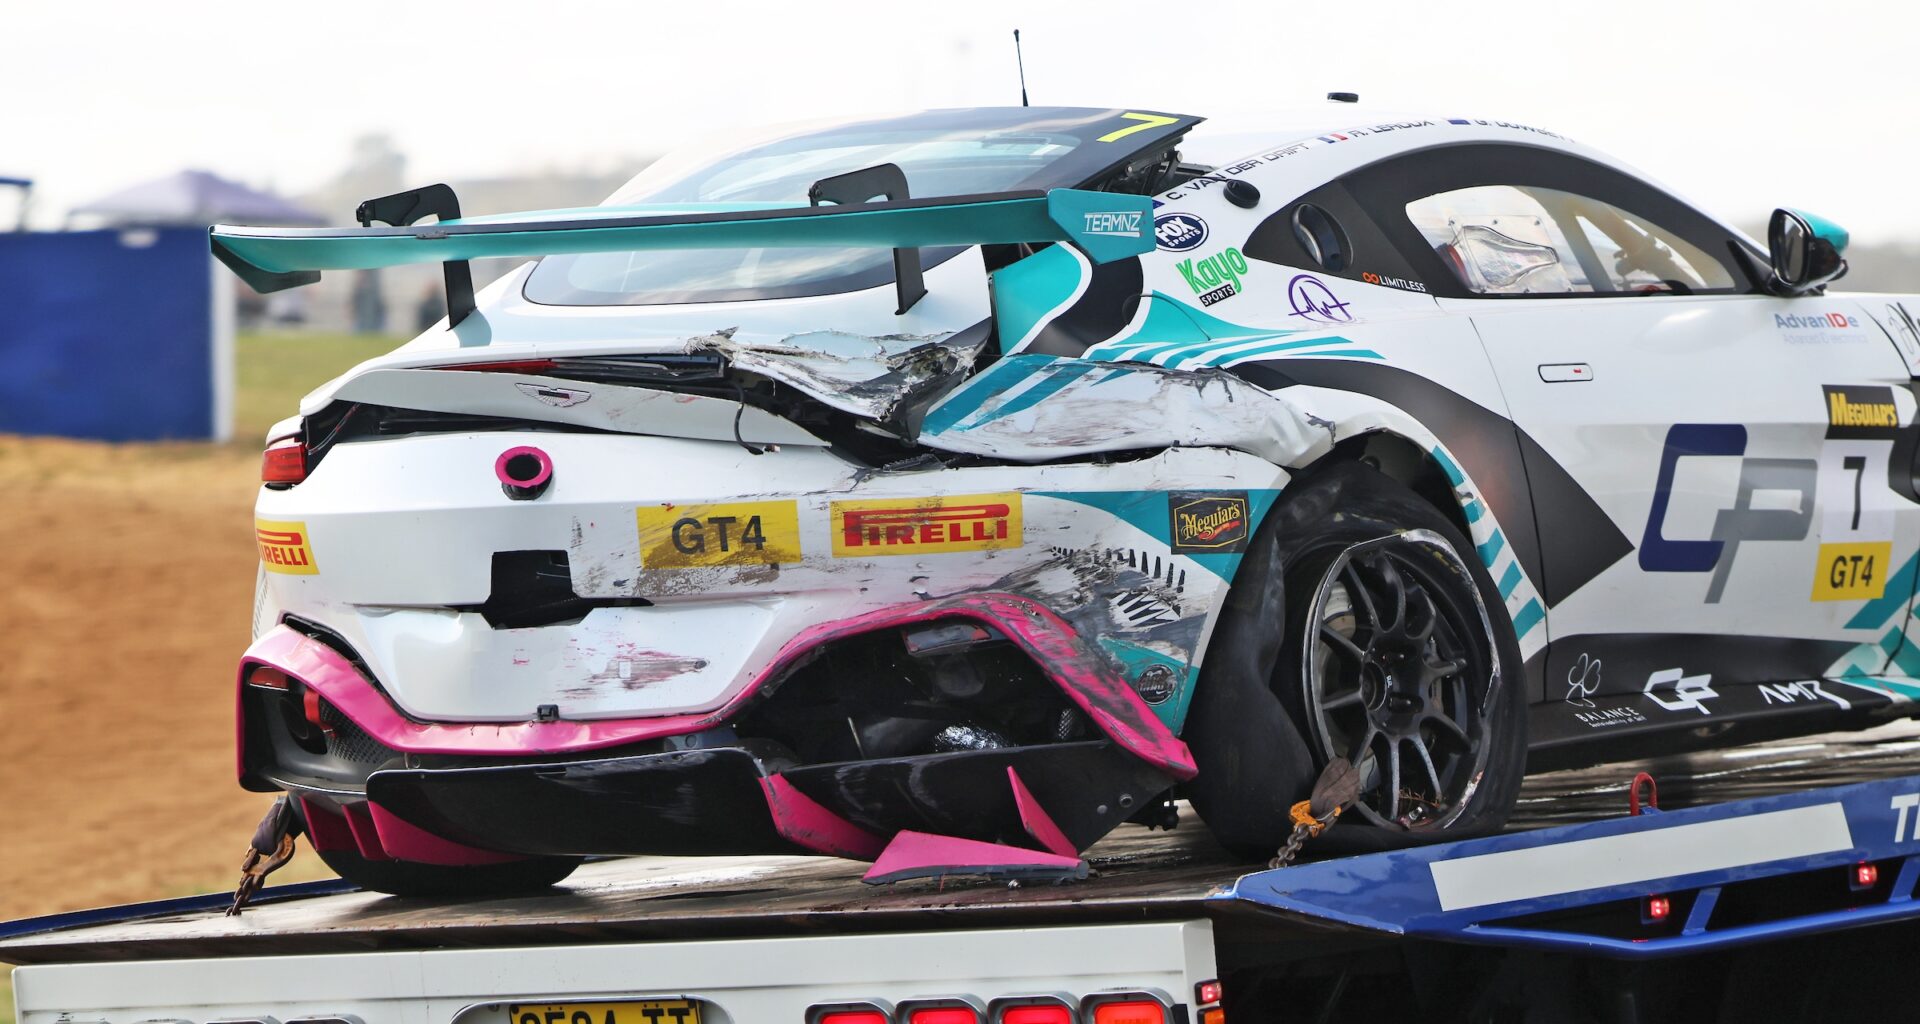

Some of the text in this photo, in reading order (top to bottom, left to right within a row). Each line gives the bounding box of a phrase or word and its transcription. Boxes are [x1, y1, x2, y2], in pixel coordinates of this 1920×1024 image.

[1096, 112, 1180, 143] 7
[1224, 159, 1264, 176] DER
[1261, 142, 1310, 162] DRIFT
[1084, 213, 1142, 232] TEAMNZ
[1154, 216, 1196, 243] FOX
[1167, 228, 1201, 248] SPORTS
[1175, 247, 1248, 294] Kayo
[1379, 275, 1426, 292] LIMITLESS
[1201, 284, 1235, 307] SPORTS
[1774, 313, 1860, 329] AdvanIDe
[1843, 456, 1867, 530] 7
[671, 515, 766, 555] GT4
[844, 503, 1010, 547] PIRELLI
[1180, 502, 1241, 540] Meguiar's
[1830, 555, 1875, 588] GT4
[1758, 680, 1851, 709] AMR
[1574, 706, 1640, 722] BALANCE
